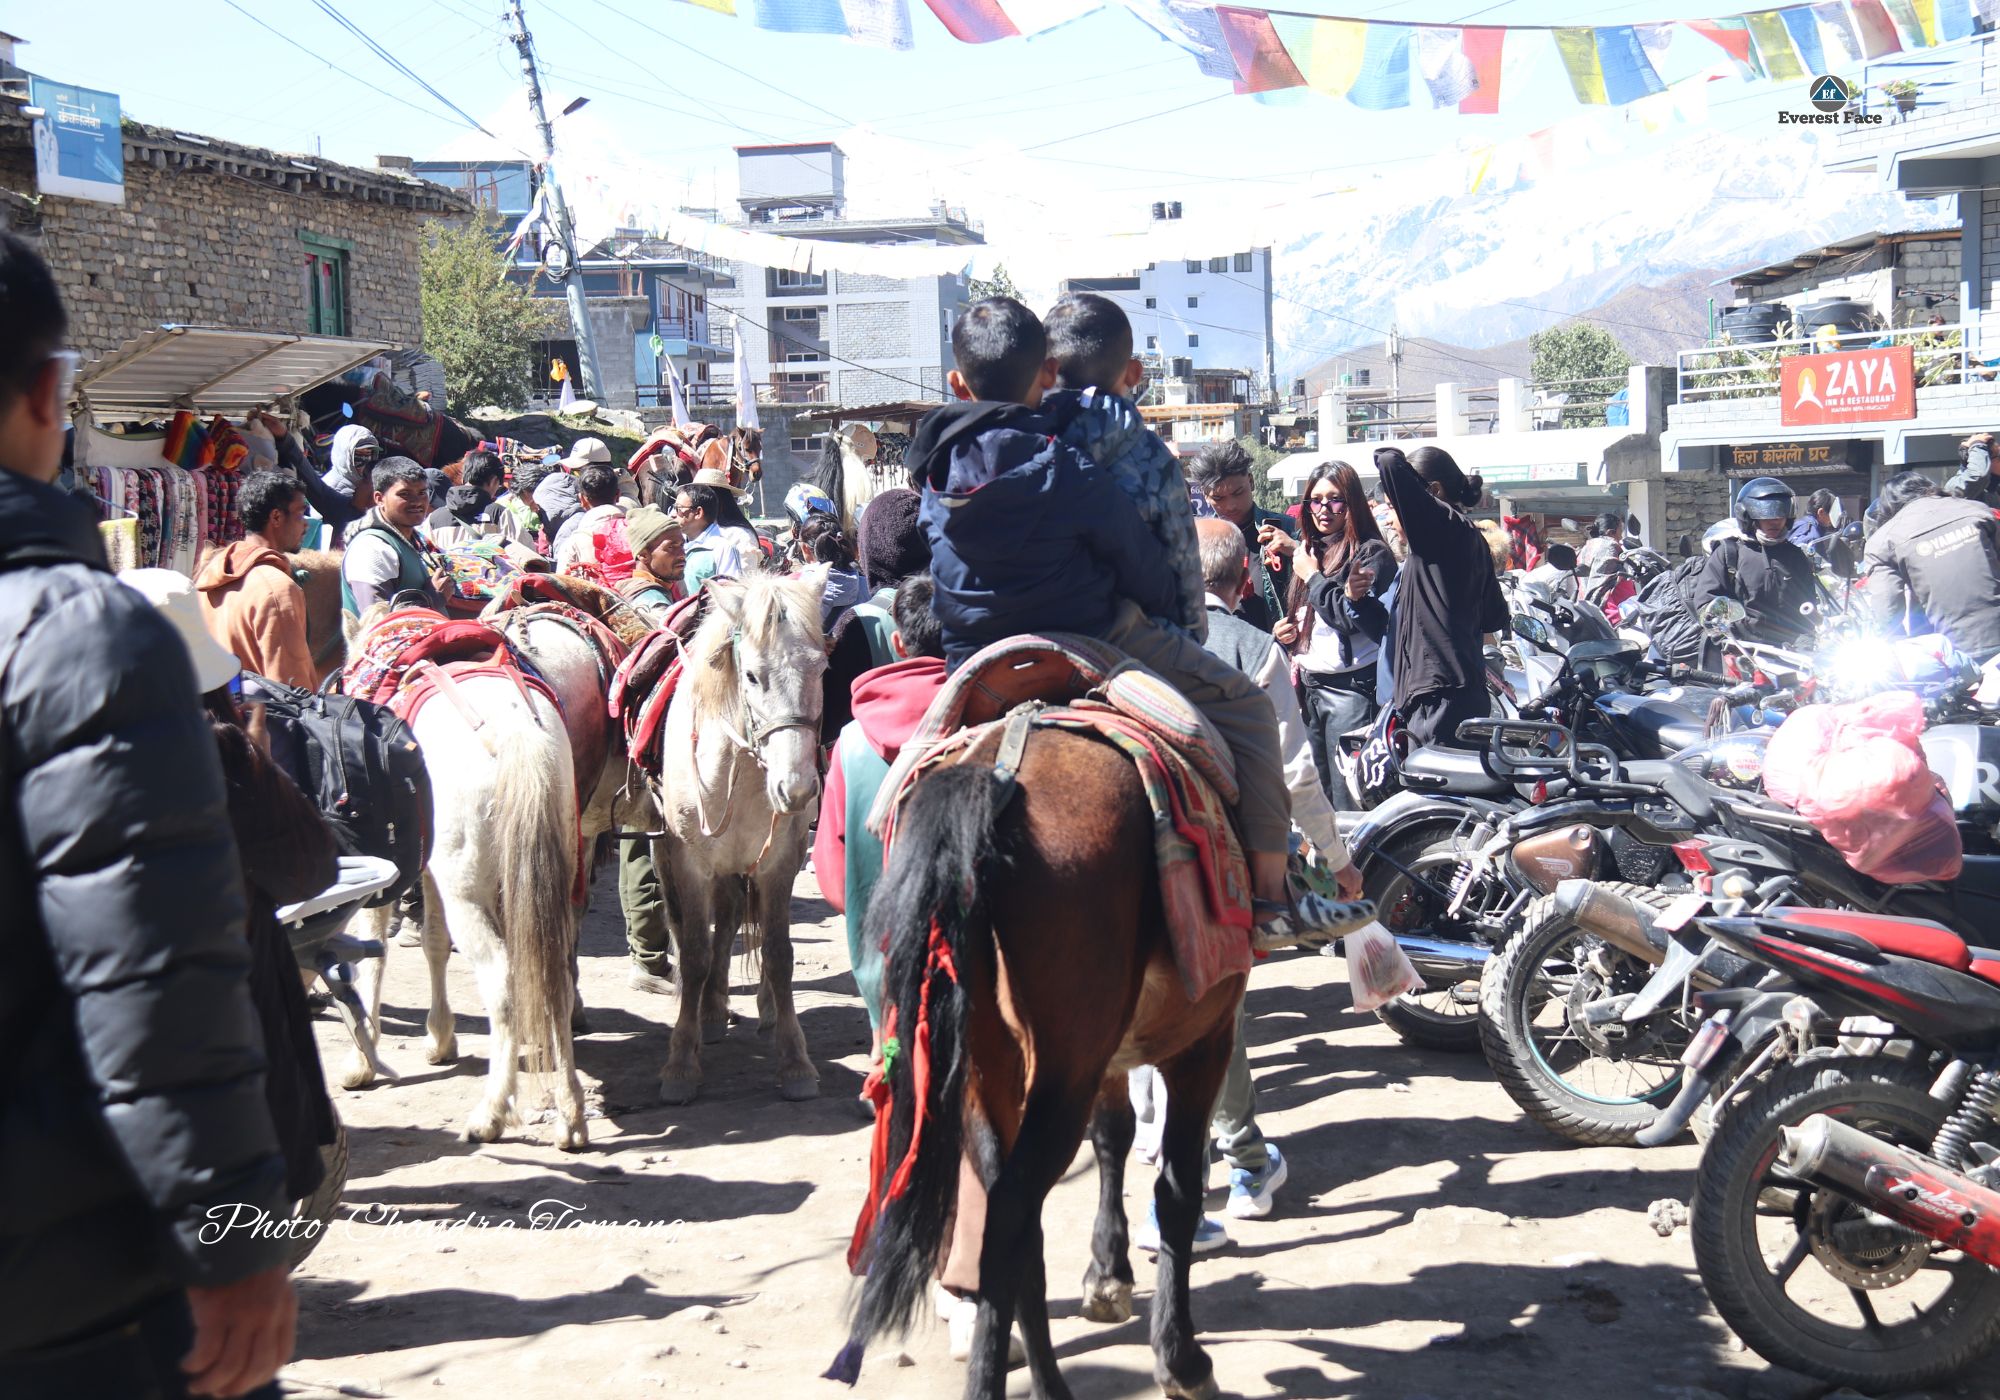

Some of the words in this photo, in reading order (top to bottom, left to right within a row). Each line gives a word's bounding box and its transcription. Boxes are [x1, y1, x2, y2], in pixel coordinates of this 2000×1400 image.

[1825, 356, 1896, 397] ZAYA
[1825, 398, 1838, 406] INN
[1847, 394, 1896, 405] RESTAURANT
[1733, 447, 1758, 464] हिरा
[1762, 443, 1804, 464] कोसेली
[1808, 446, 1830, 462] घर
[1930, 523, 1980, 550] YAMAHA
